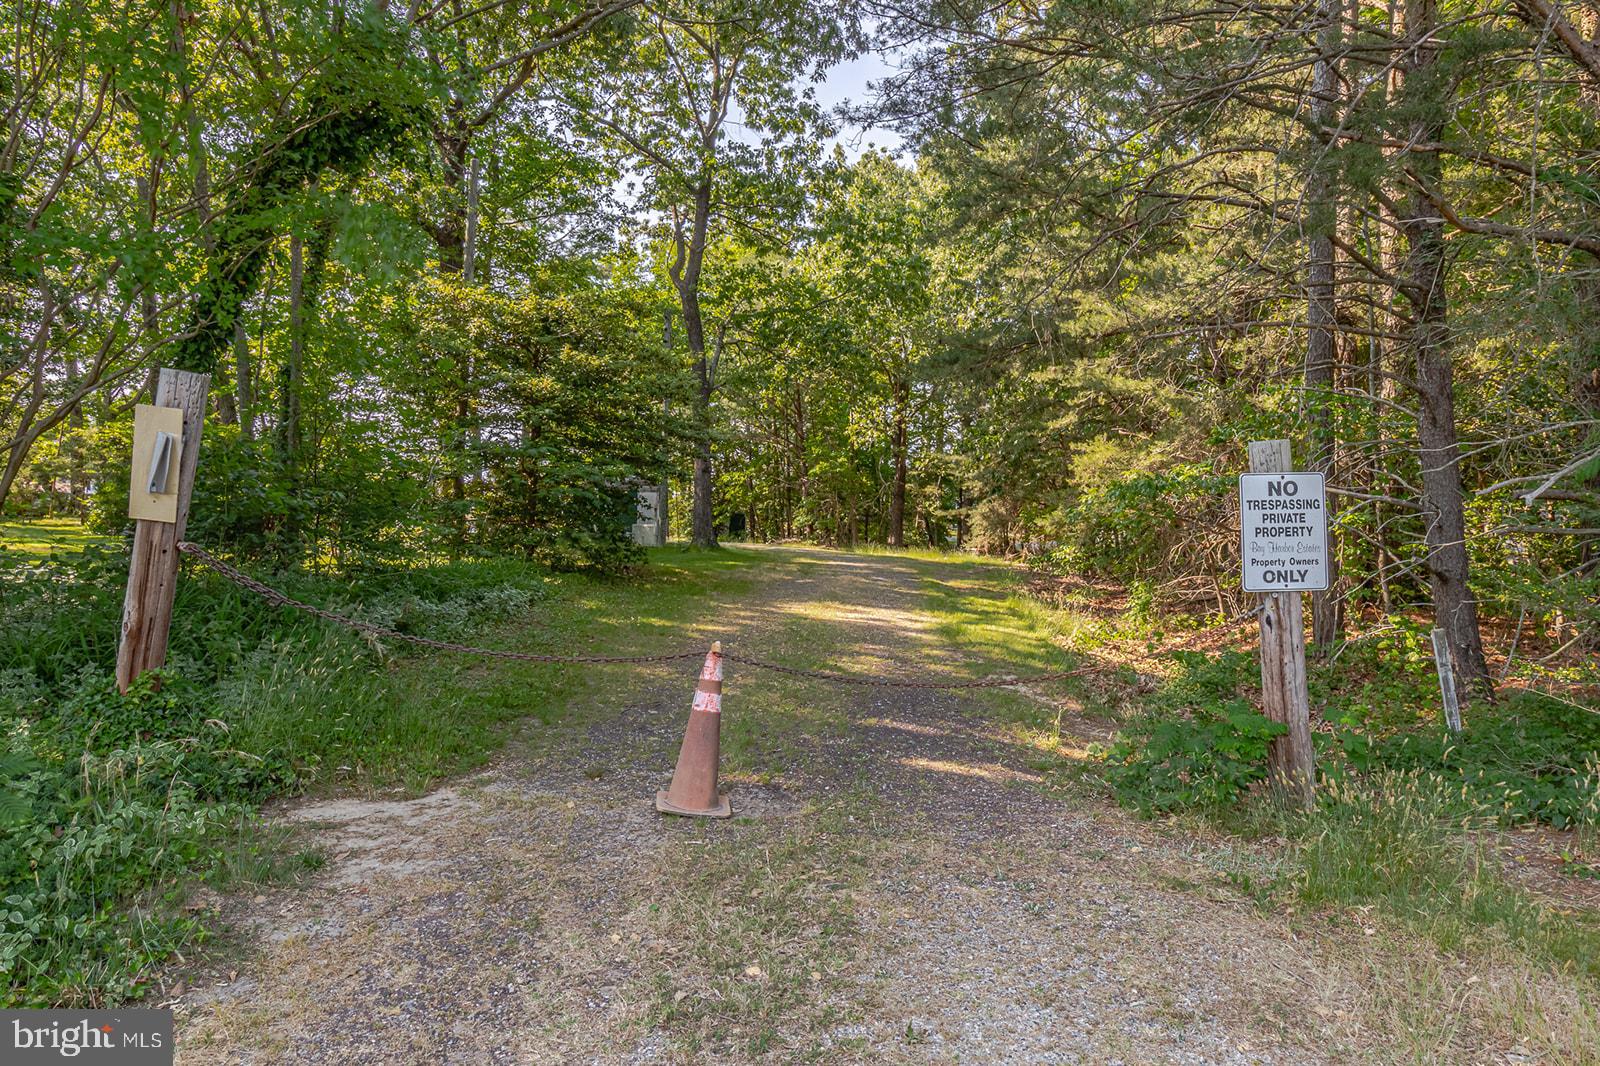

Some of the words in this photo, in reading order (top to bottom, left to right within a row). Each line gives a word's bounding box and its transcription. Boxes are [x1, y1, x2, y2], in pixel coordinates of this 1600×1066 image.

[1267, 480, 1299, 497] NO
[1246, 499, 1320, 510] TRESPASSING
[1262, 512, 1306, 524] PRIVATE
[1255, 526, 1313, 538] PROPERTY
[1250, 541, 1265, 556] Bay
[1296, 541, 1321, 554] Estates
[1251, 558, 1286, 568] Property
[1289, 557, 1320, 566] Owners
[1262, 569, 1309, 583] ONLY
